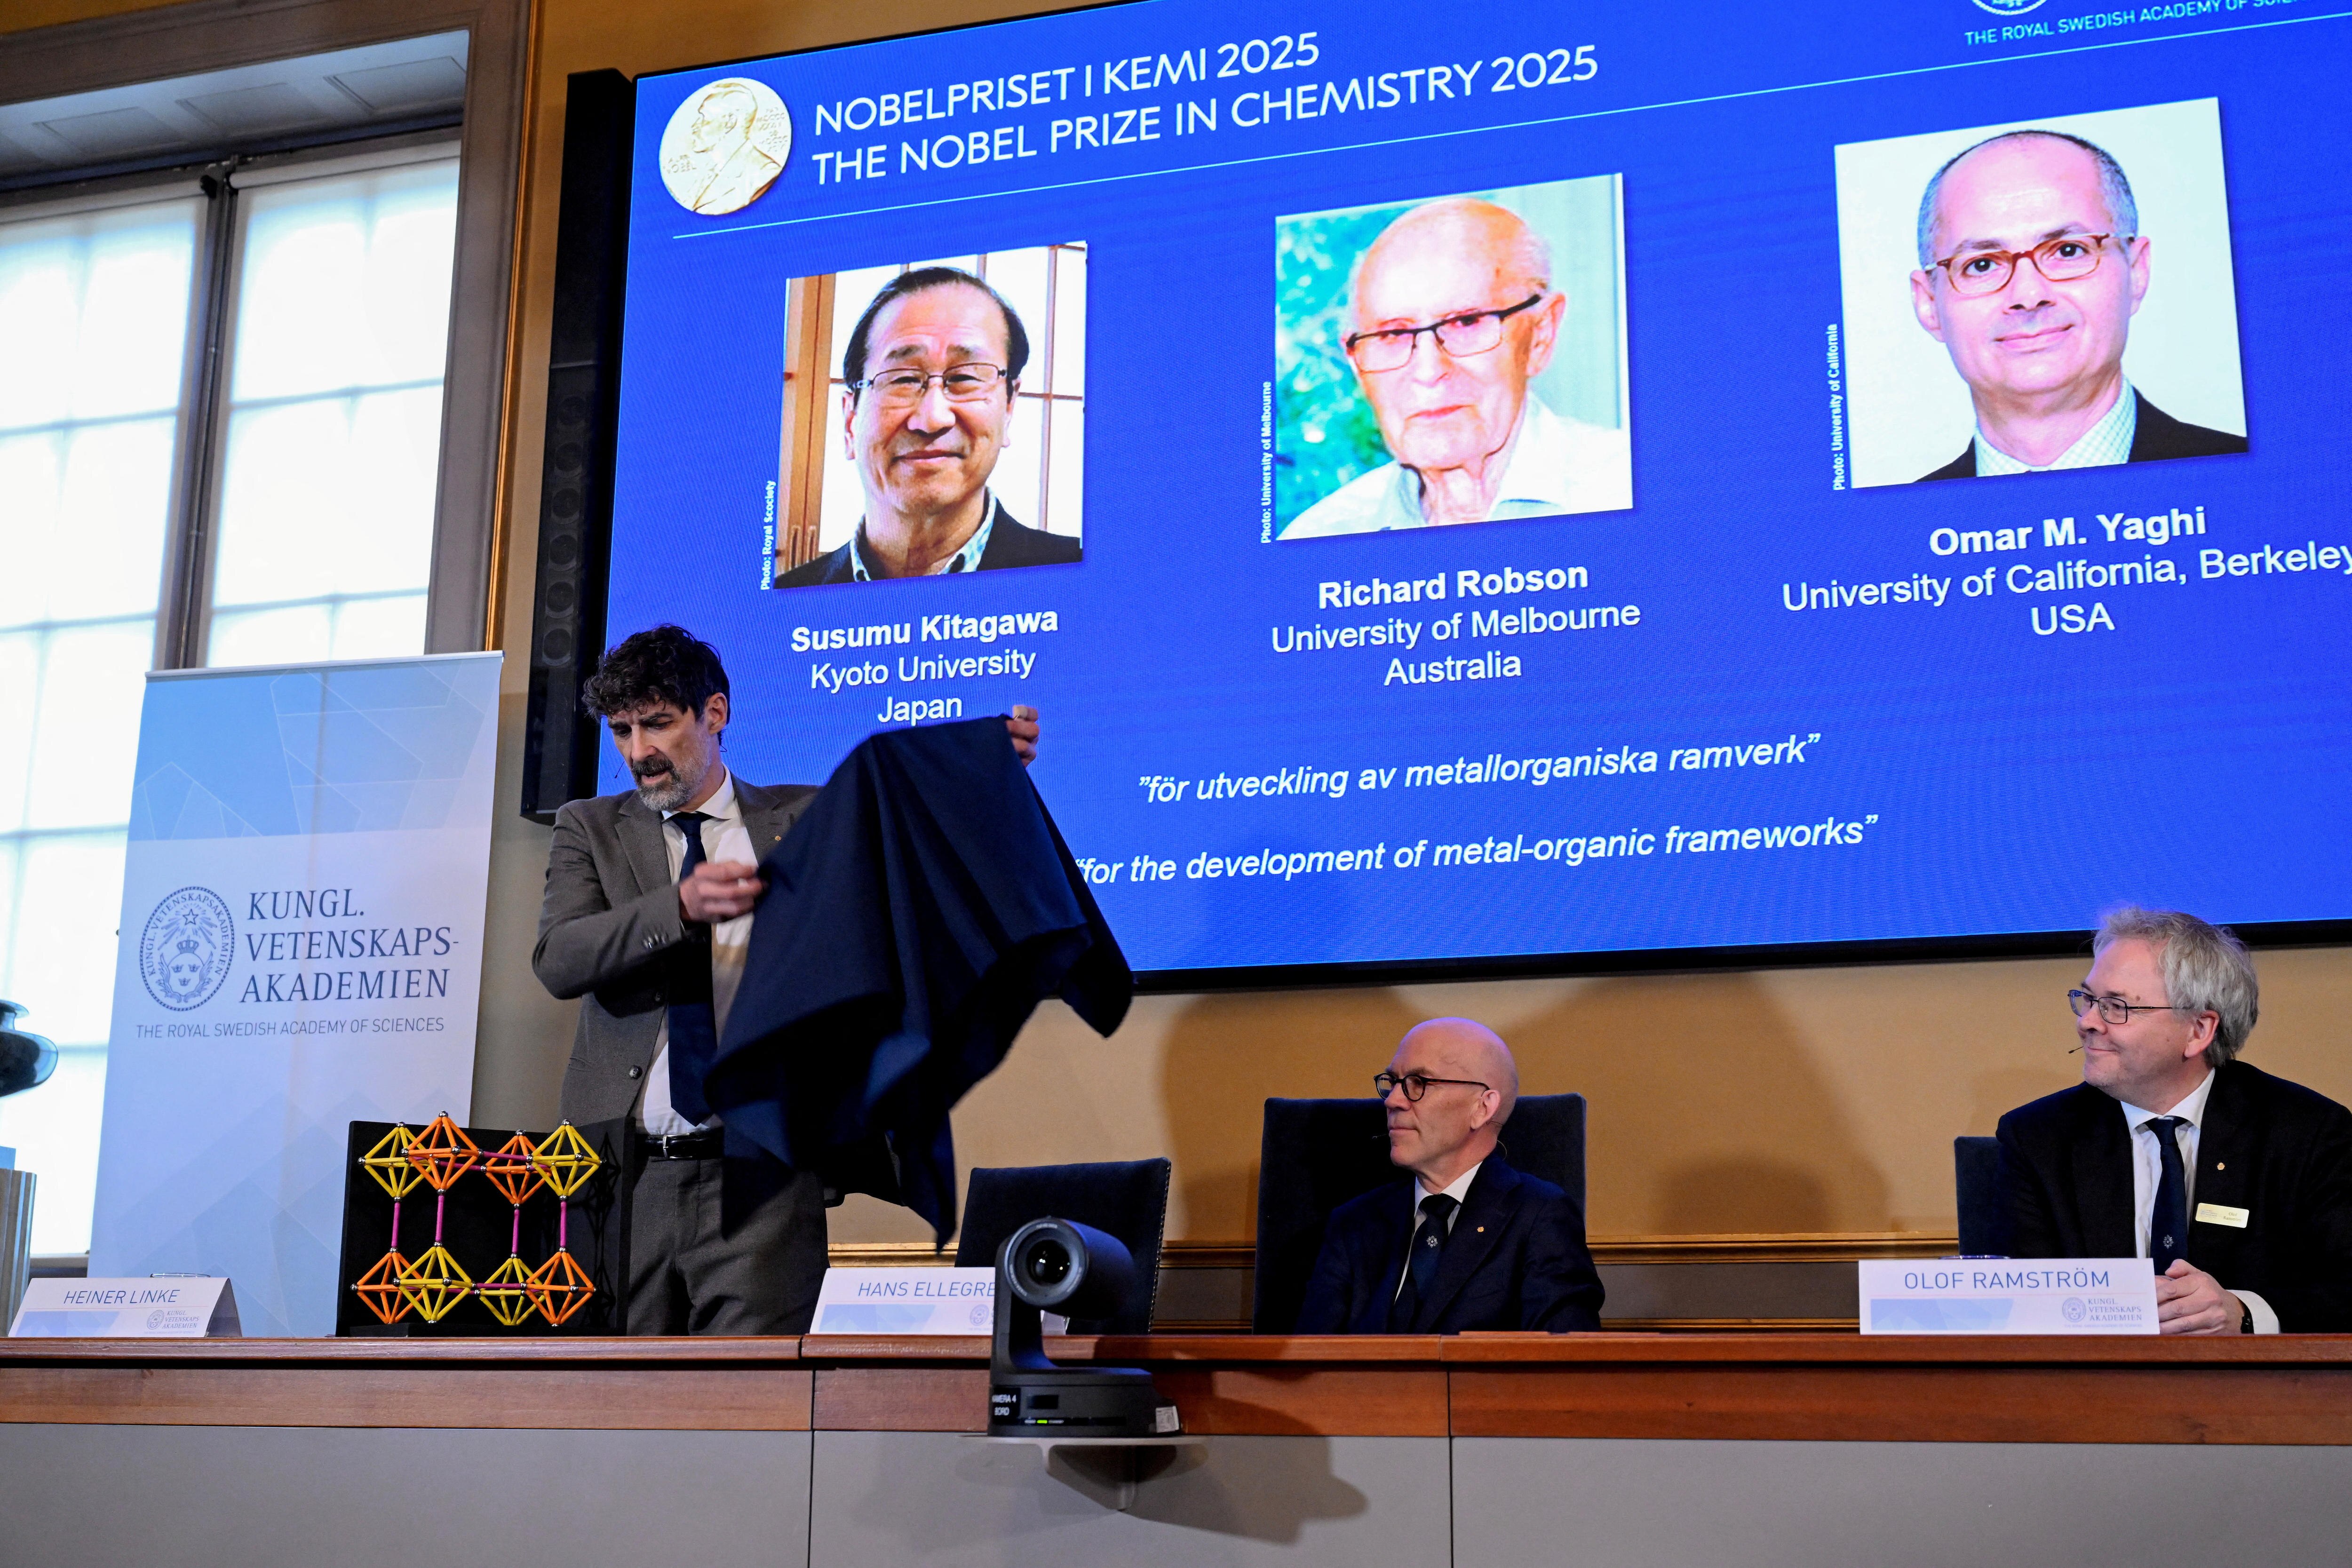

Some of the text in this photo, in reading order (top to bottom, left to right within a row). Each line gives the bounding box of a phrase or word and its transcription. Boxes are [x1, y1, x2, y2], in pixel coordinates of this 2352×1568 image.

[1964, 0, 2249, 46] THE ROYAL SWEDISH ACADEMY OF
[815, 67, 1076, 136] NOBELPRISET
[1085, 64, 1092, 97] I
[1104, 48, 1206, 95] KEMI
[1217, 32, 1319, 78] 2025
[811, 44, 1598, 185] THE NOBEL PRIZE IN CHEMISTRY 2025
[1825, 323, 1845, 491] Photo: University of California
[1261, 381, 1273, 544] Photo: University of Melbourne
[760, 480, 777, 590] Photo: Royal Scociety
[1930, 506, 2206, 556] Omar M. Yaghi
[1319, 566, 1588, 609] Richard Robson
[1783, 541, 2352, 612] University of California, Berkeley
[790, 611, 1058, 653] Susumu Kitagawa
[1272, 605, 1641, 653] University of Melbourne
[2031, 602, 2115, 636] USA
[811, 648, 1037, 694] Kyoto University
[1383, 650, 1522, 686] Australia
[877, 696, 962, 727] Japan
[1139, 732, 1821, 803] ”för utveckling av metallorganiska ramverk”
[1130, 854, 1177, 882] the
[1186, 842, 1386, 882] development
[1393, 839, 1429, 868] of
[1433, 827, 1656, 867] metal-organic
[1665, 813, 1879, 854] frameworks”
[247, 889, 365, 921] KUNGL.
[151, 893, 230, 976] VETENSKAPSAKADEMIEN
[245, 926, 460, 962] VETENSKAPS-
[239, 968, 450, 1003] AKADEMIEN
[136, 1017, 444, 1039] THE ROYAL SWEDISH ACADEMY OF SCIENCES
[64, 1289, 181, 1304] HEINER LINKE
[858, 1282, 995, 1297] HANS ELLEGRE
[1904, 1267, 2110, 1289] OLOF RAMSTRÖM
